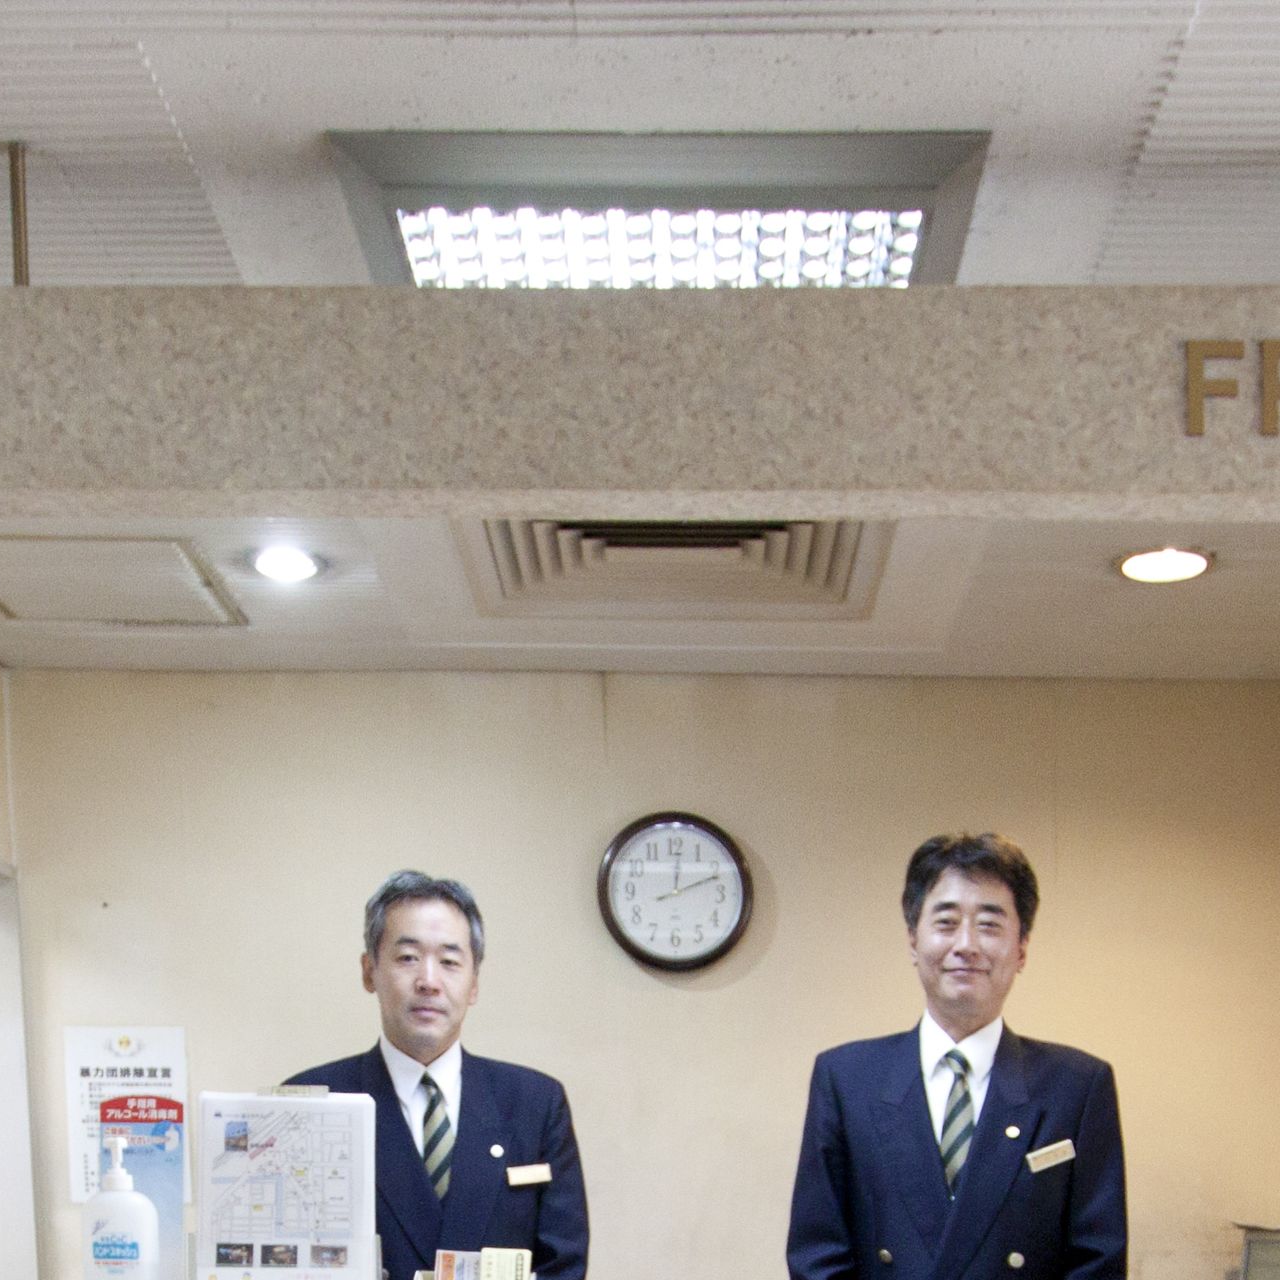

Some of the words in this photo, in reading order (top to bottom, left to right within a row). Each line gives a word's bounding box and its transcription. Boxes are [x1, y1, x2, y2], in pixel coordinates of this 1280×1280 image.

[646, 843, 658, 861] 11
[667, 837, 683, 856] 12
[695, 844, 701, 862] 1
[629, 859, 644, 877] 10
[625, 882, 635, 900] 9
[716, 884, 726, 903] 3
[632, 905, 641, 925] 8
[710, 909, 719, 927] 4
[649, 923, 658, 942] 7
[671, 928, 681, 947] 6
[694, 925, 704, 943] 5
